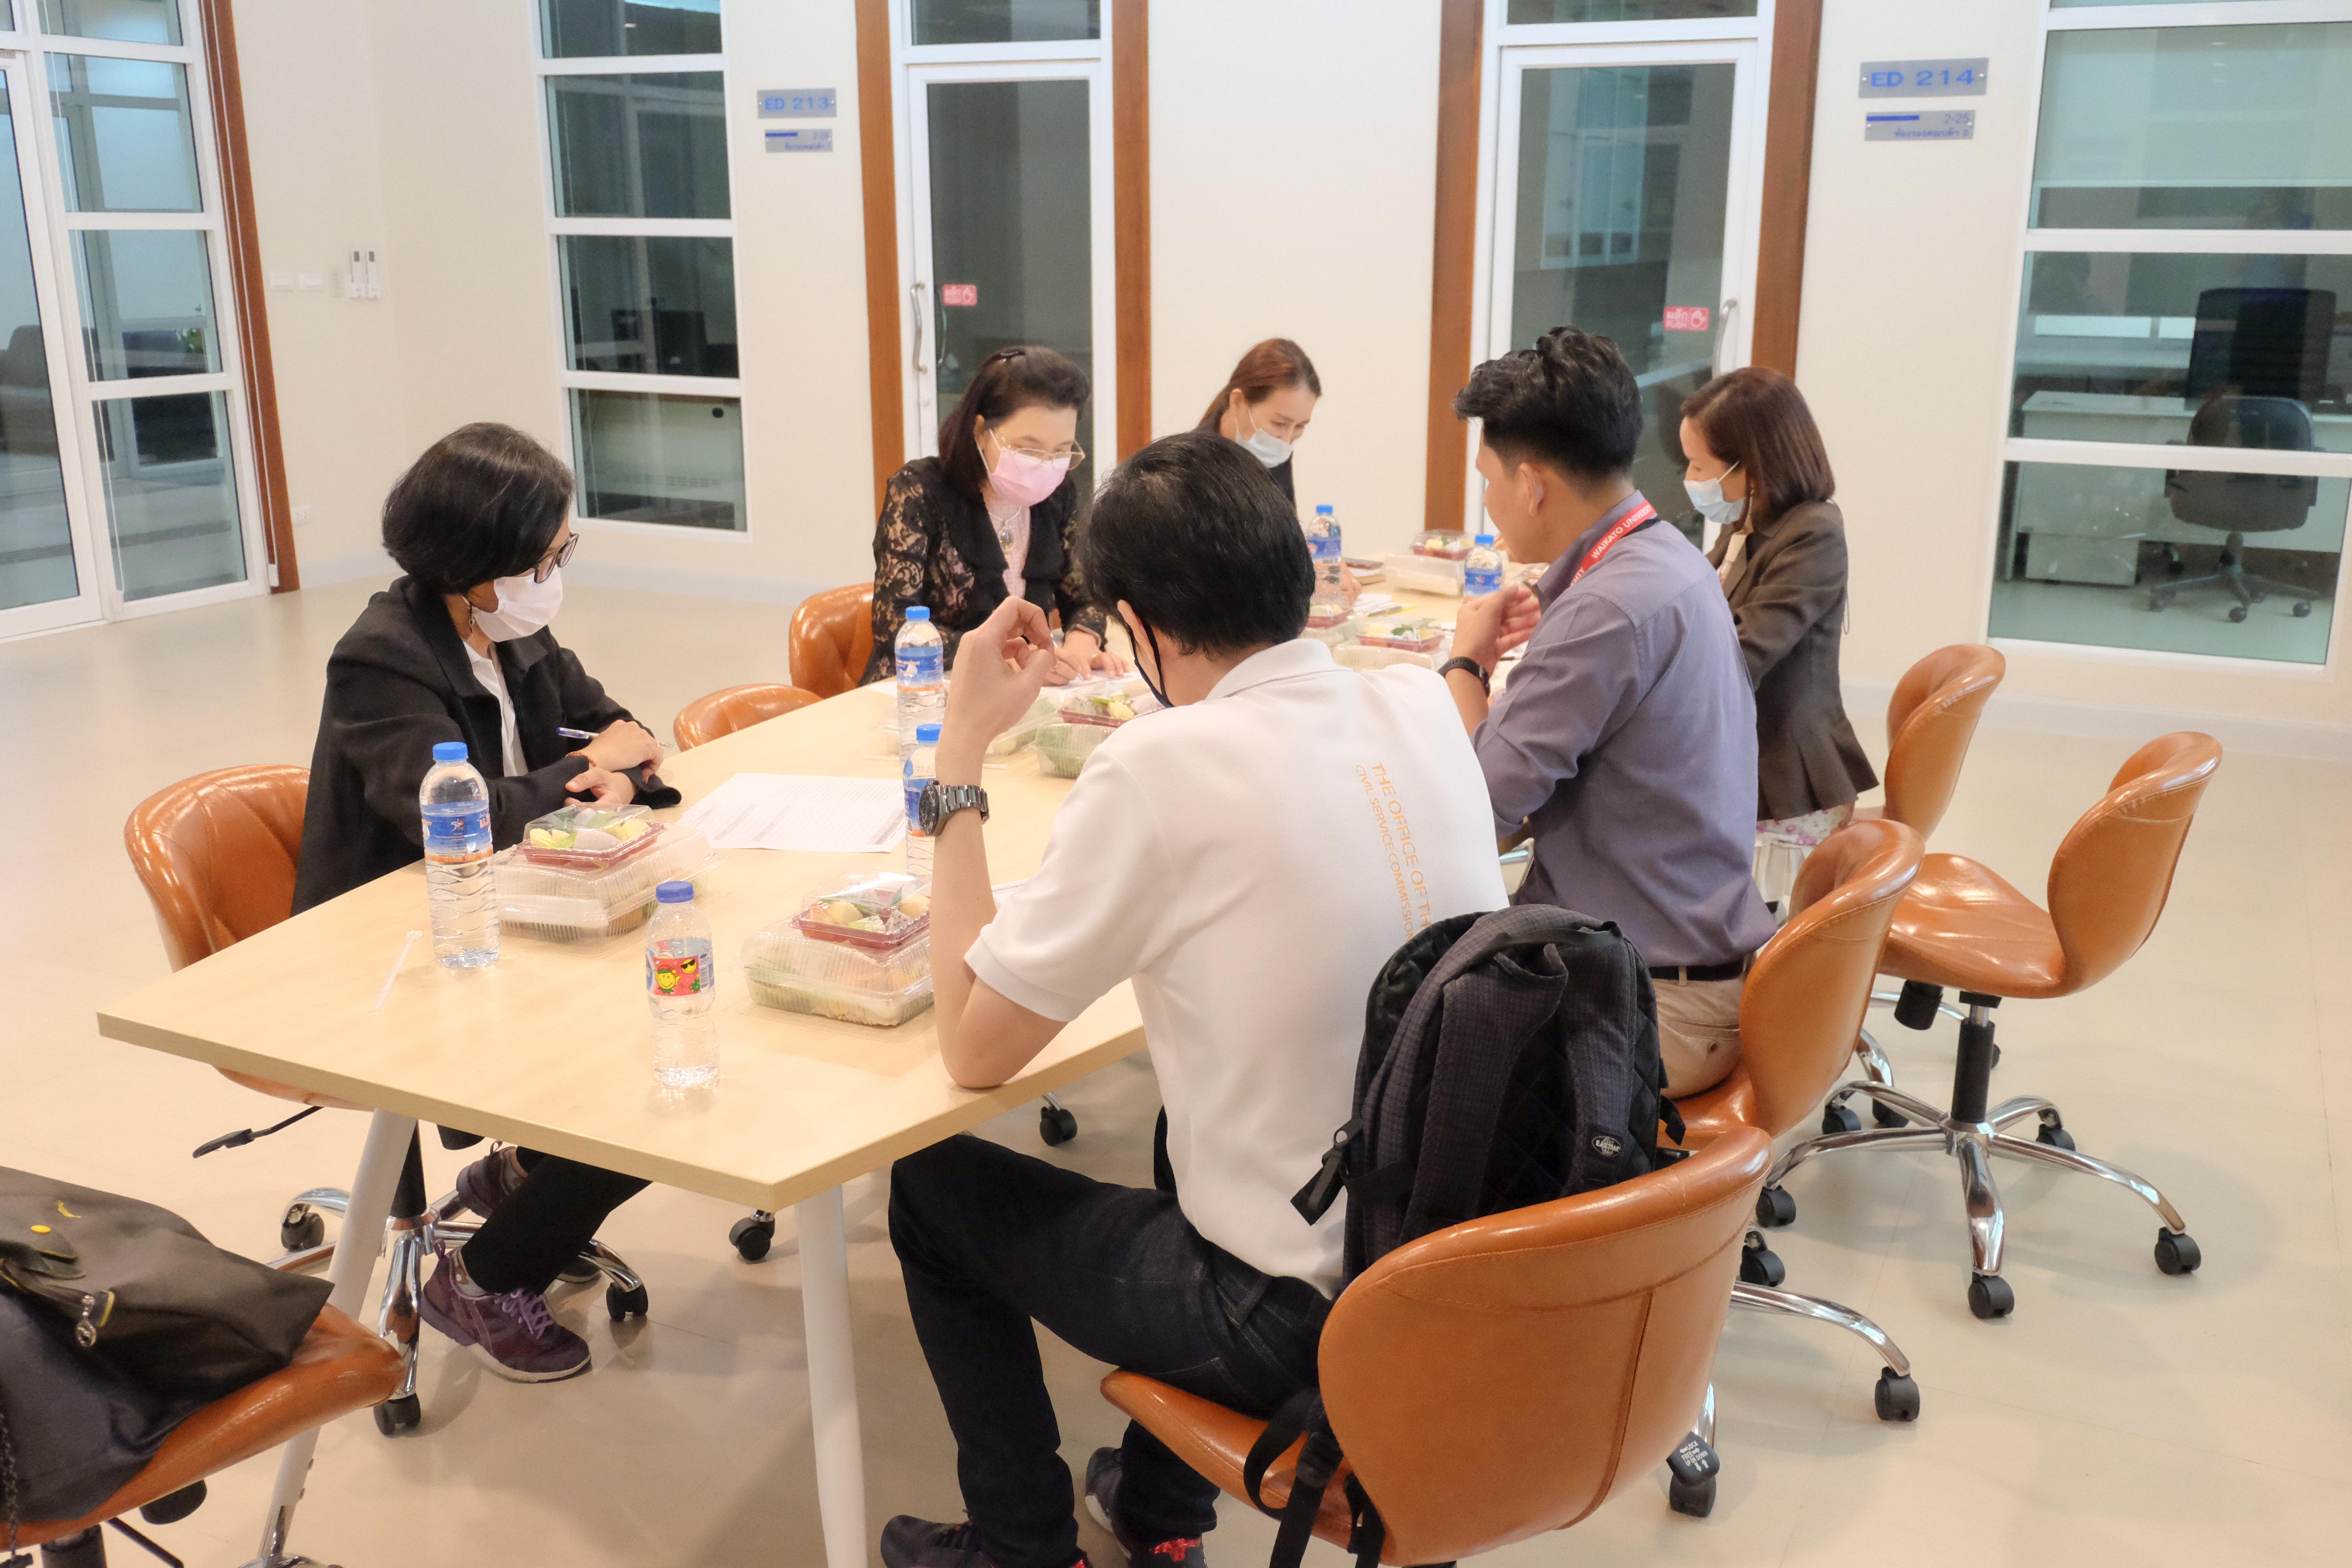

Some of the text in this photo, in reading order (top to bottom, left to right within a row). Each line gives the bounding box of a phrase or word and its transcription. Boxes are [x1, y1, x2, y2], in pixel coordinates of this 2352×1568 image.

[1871, 69, 1975, 87] ED 214
[765, 97, 830, 110] ED 213
[1666, 308, 1688, 320] ผลัก
[1591, 527, 1623, 559] WAIKATO
[1355, 764, 1374, 796] CIVIL
[1369, 797, 1395, 850] SERVICE
[1372, 761, 1433, 928] THE OFFICE OF TH
[1685, 1440, 1699, 1450] LOCK
